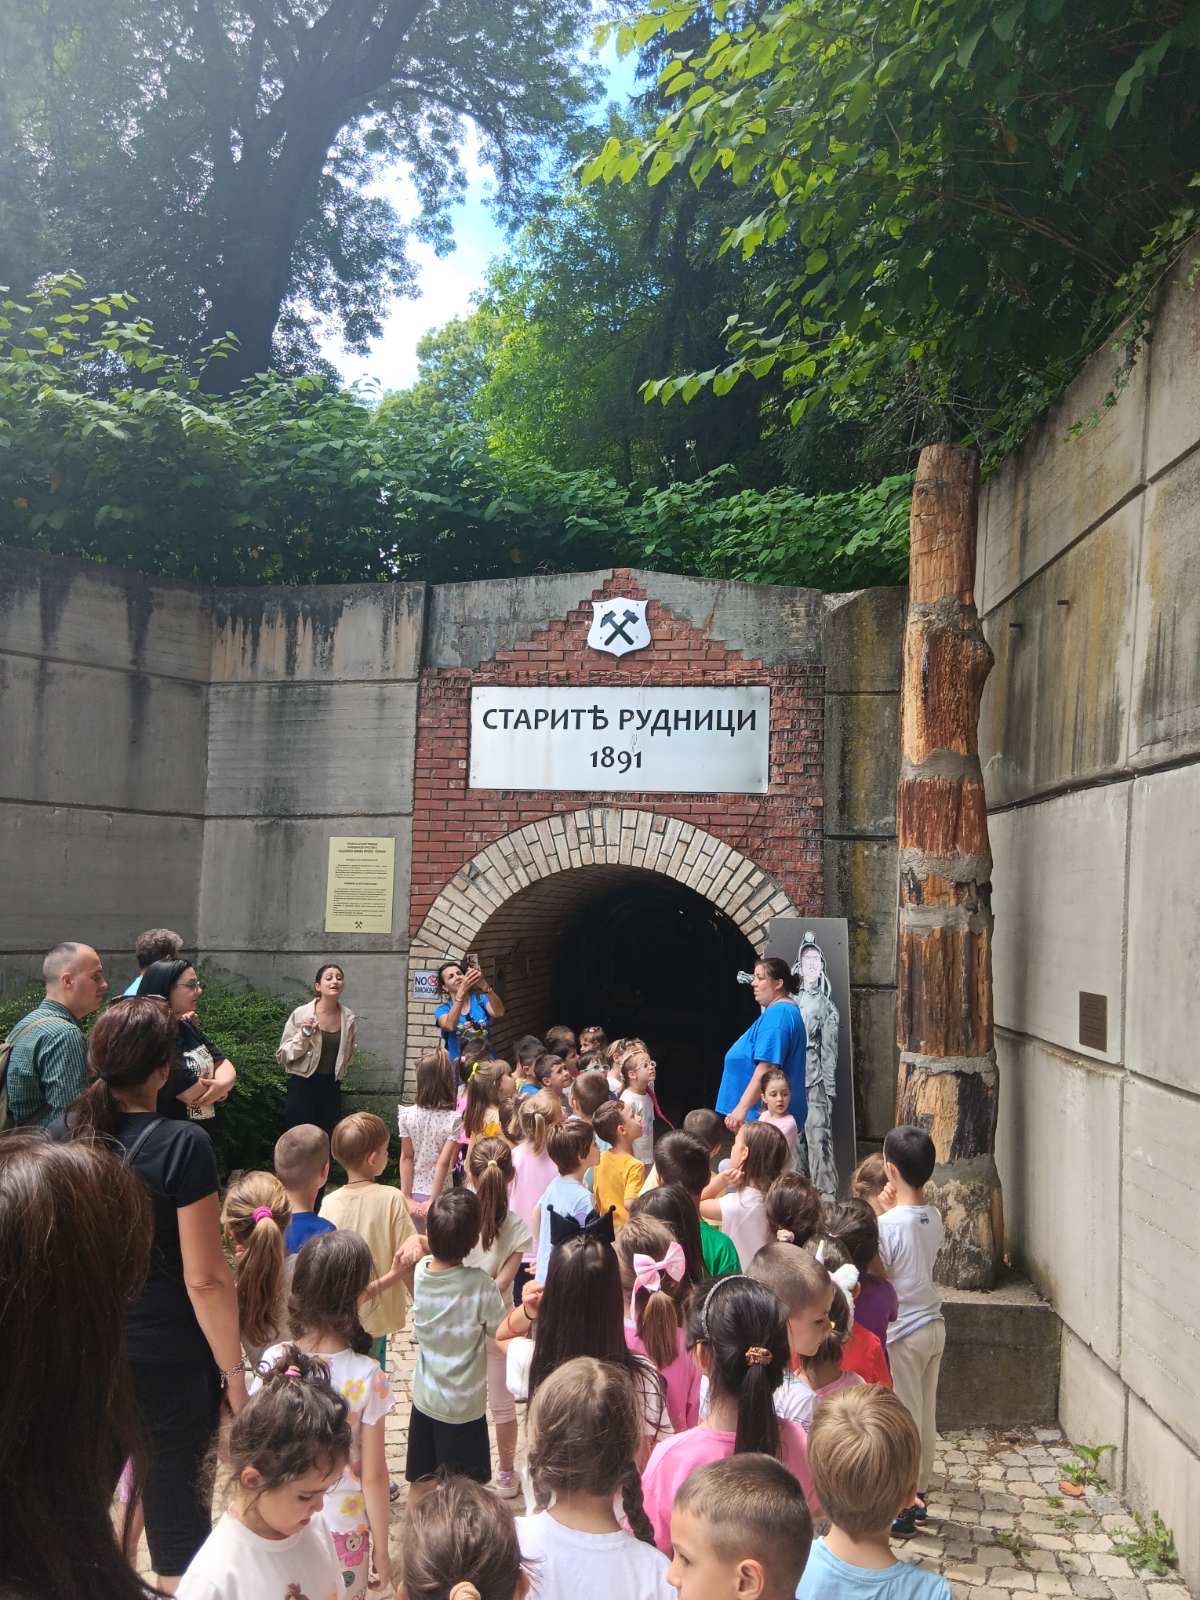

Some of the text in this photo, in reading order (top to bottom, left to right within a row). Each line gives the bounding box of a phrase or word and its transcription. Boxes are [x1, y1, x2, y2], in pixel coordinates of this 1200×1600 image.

[619, 709, 757, 737] РУДНИЦИ
[590, 746, 642, 774] 1891
[415, 976, 428, 986] NO
